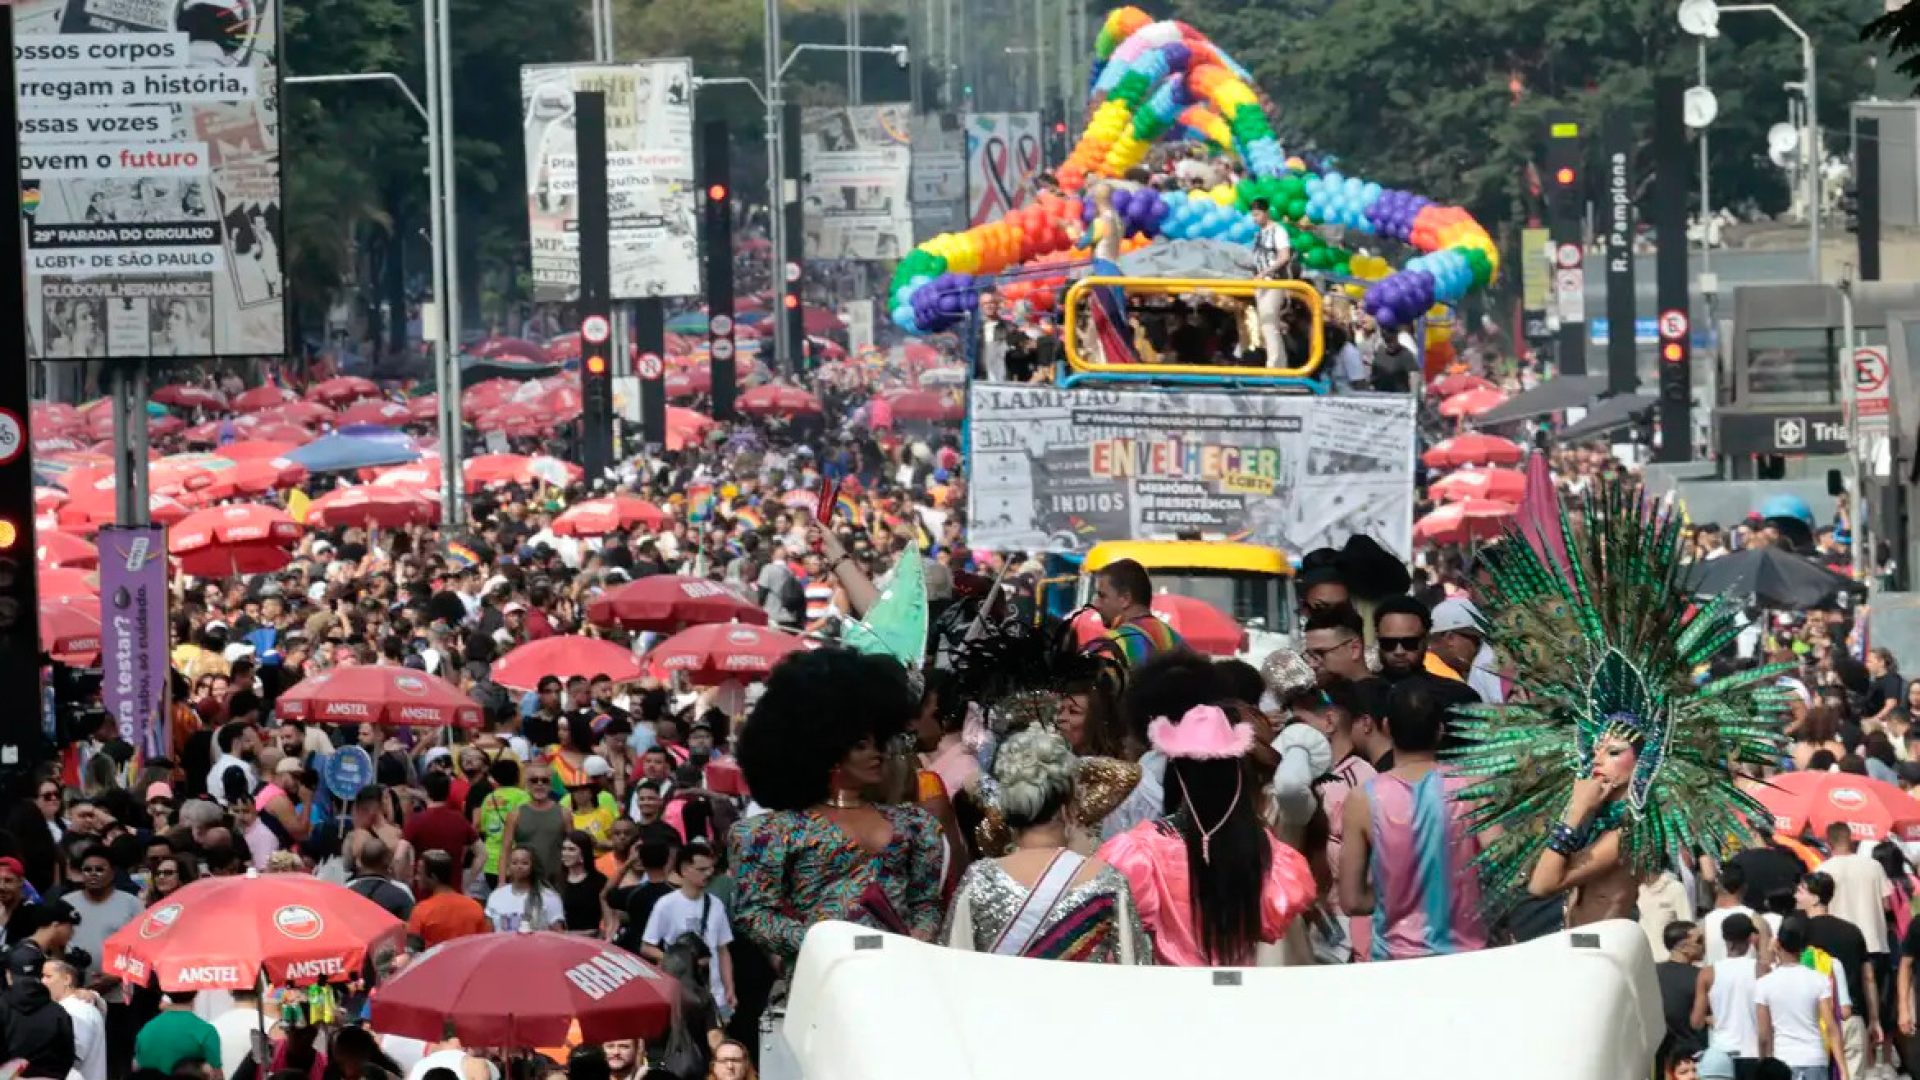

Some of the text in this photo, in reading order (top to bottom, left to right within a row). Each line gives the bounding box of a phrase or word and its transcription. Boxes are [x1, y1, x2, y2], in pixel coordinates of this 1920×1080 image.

[15, 42, 176, 62] ossos corpos
[20, 73, 249, 100] rregam a história,
[17, 116, 160, 134] ssas vozes
[19, 151, 199, 171] ovem o futuro
[607, 175, 650, 188] gulho
[1610, 152, 1631, 272] R. Pamplona
[58, 229, 117, 242] PARADA
[120, 228, 142, 241] DO
[144, 227, 214, 241] ORGULHO
[35, 250, 215, 269] LGBT+ DE SÃO PAULO
[1812, 422, 1849, 441] Tria
[1092, 434, 1279, 479] ENVELHECER
[114, 616, 133, 695] testar?
[326, 702, 369, 716] AMSTEL
[400, 707, 441, 721] AMSTEL
[178, 965, 240, 983] AMSTEL
[286, 956, 345, 979] AMSTEL
